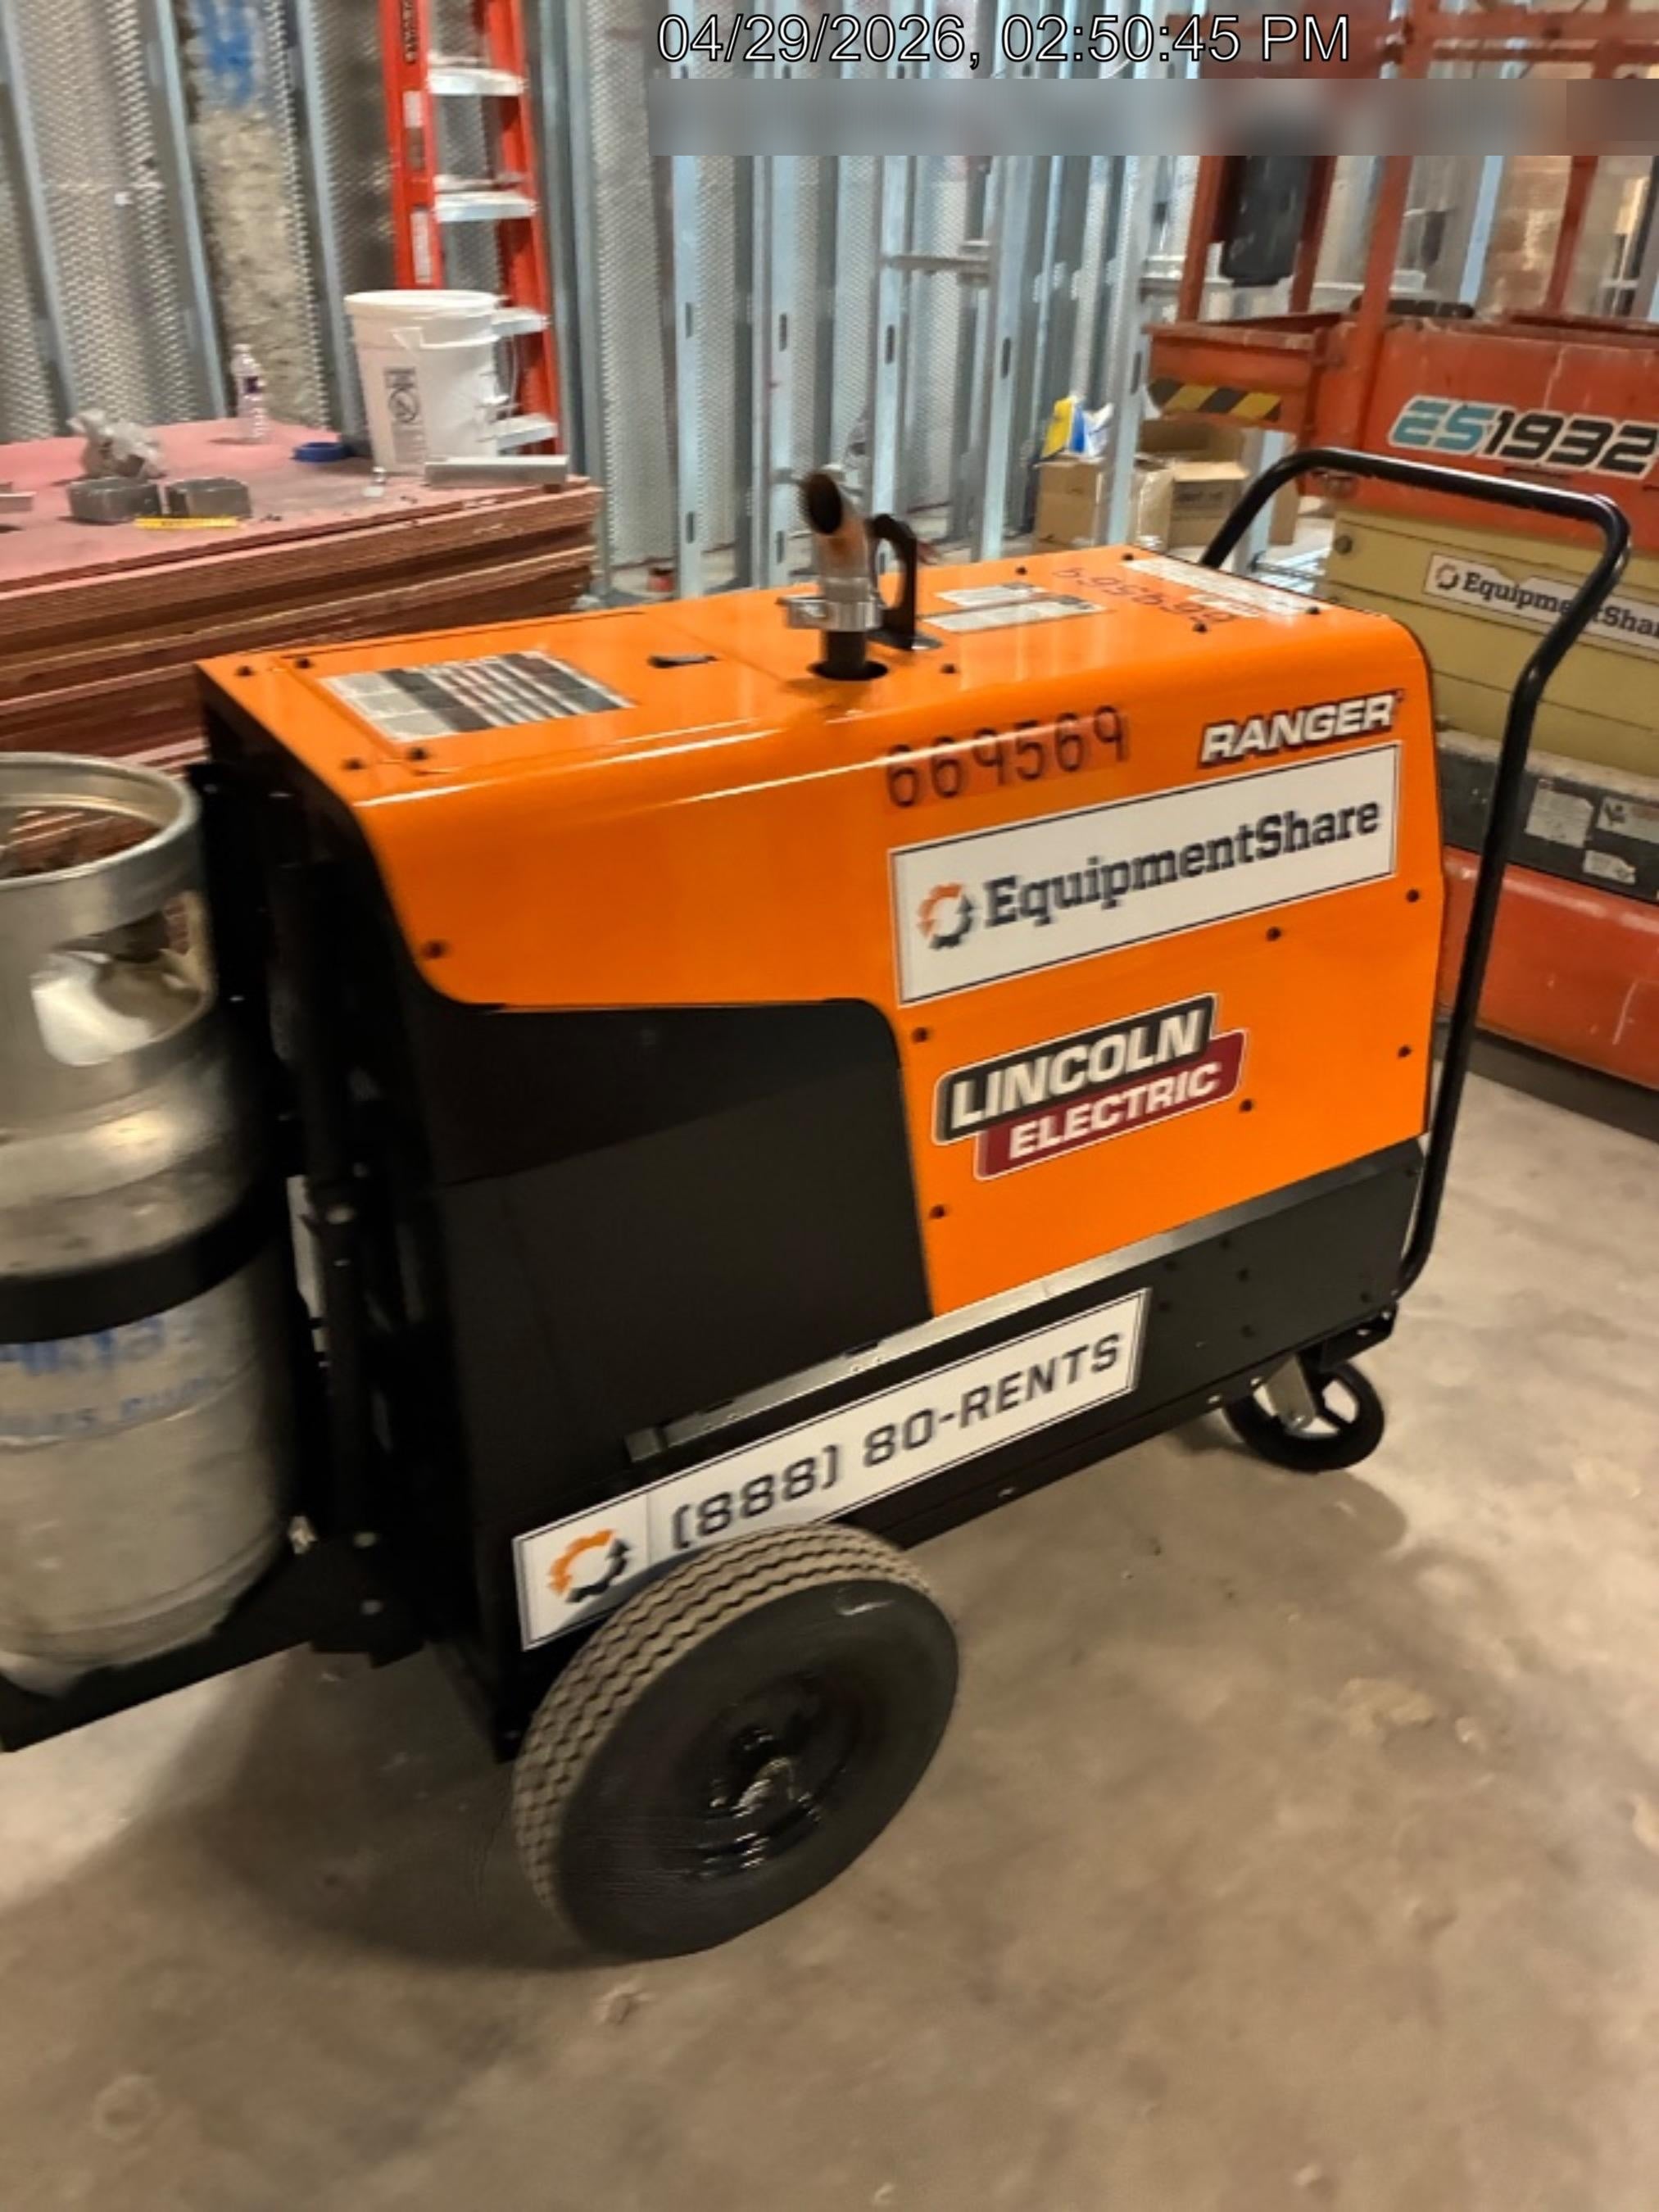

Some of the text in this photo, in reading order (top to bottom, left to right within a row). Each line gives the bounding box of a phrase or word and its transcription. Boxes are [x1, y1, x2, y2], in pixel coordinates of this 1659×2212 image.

[1390, 398, 1659, 476] ES1932
[887, 705, 1127, 809] 669569
[1199, 694, 1395, 764] RANGER
[984, 800, 1380, 927] EquipmentShare
[950, 1009, 1206, 1130] LINCOLN
[1008, 1061, 1224, 1161] ELECTRIC
[863, 1332, 1122, 1468] 80-RENTS
